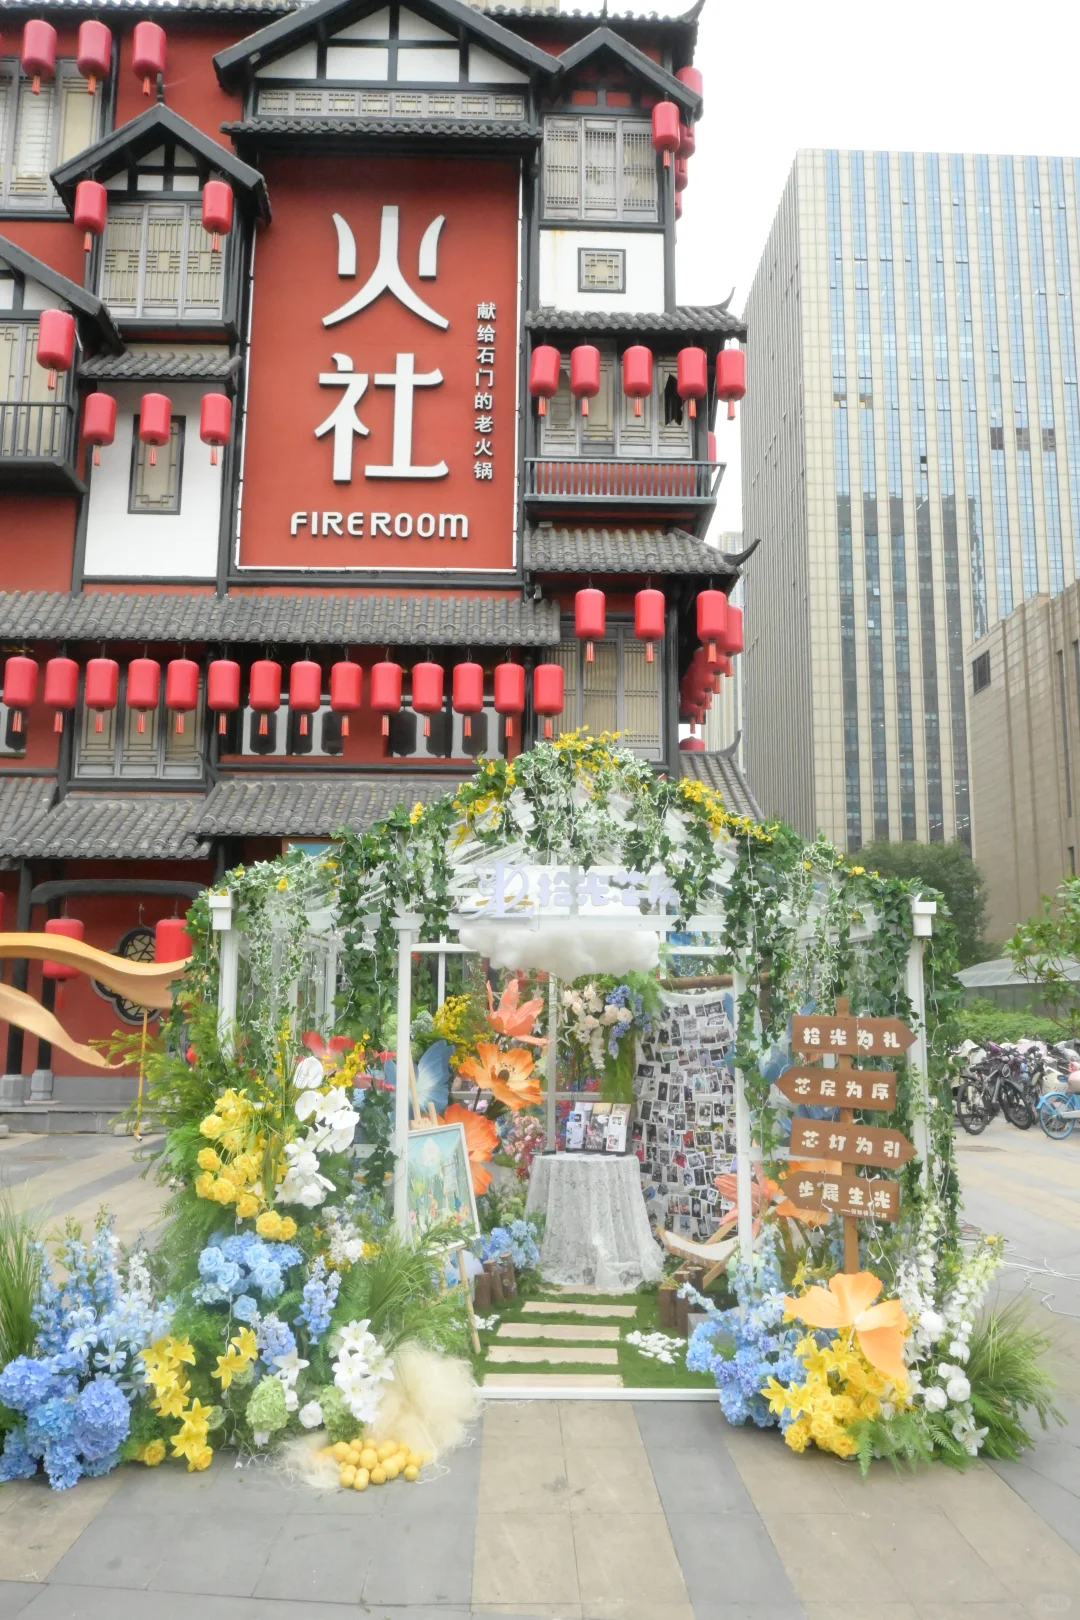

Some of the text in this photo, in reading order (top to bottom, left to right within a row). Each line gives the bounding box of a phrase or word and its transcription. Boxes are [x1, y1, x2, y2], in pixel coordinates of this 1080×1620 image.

[314, 205, 450, 483] 火社
[473, 301, 496, 480] 献给石门的老火锅
[803, 1027, 900, 1049] 拾光为礼
[794, 1077, 889, 1100] 芯房为序
[801, 1130, 900, 1159] 芯灯为引
[798, 1180, 891, 1209] 步履生光
